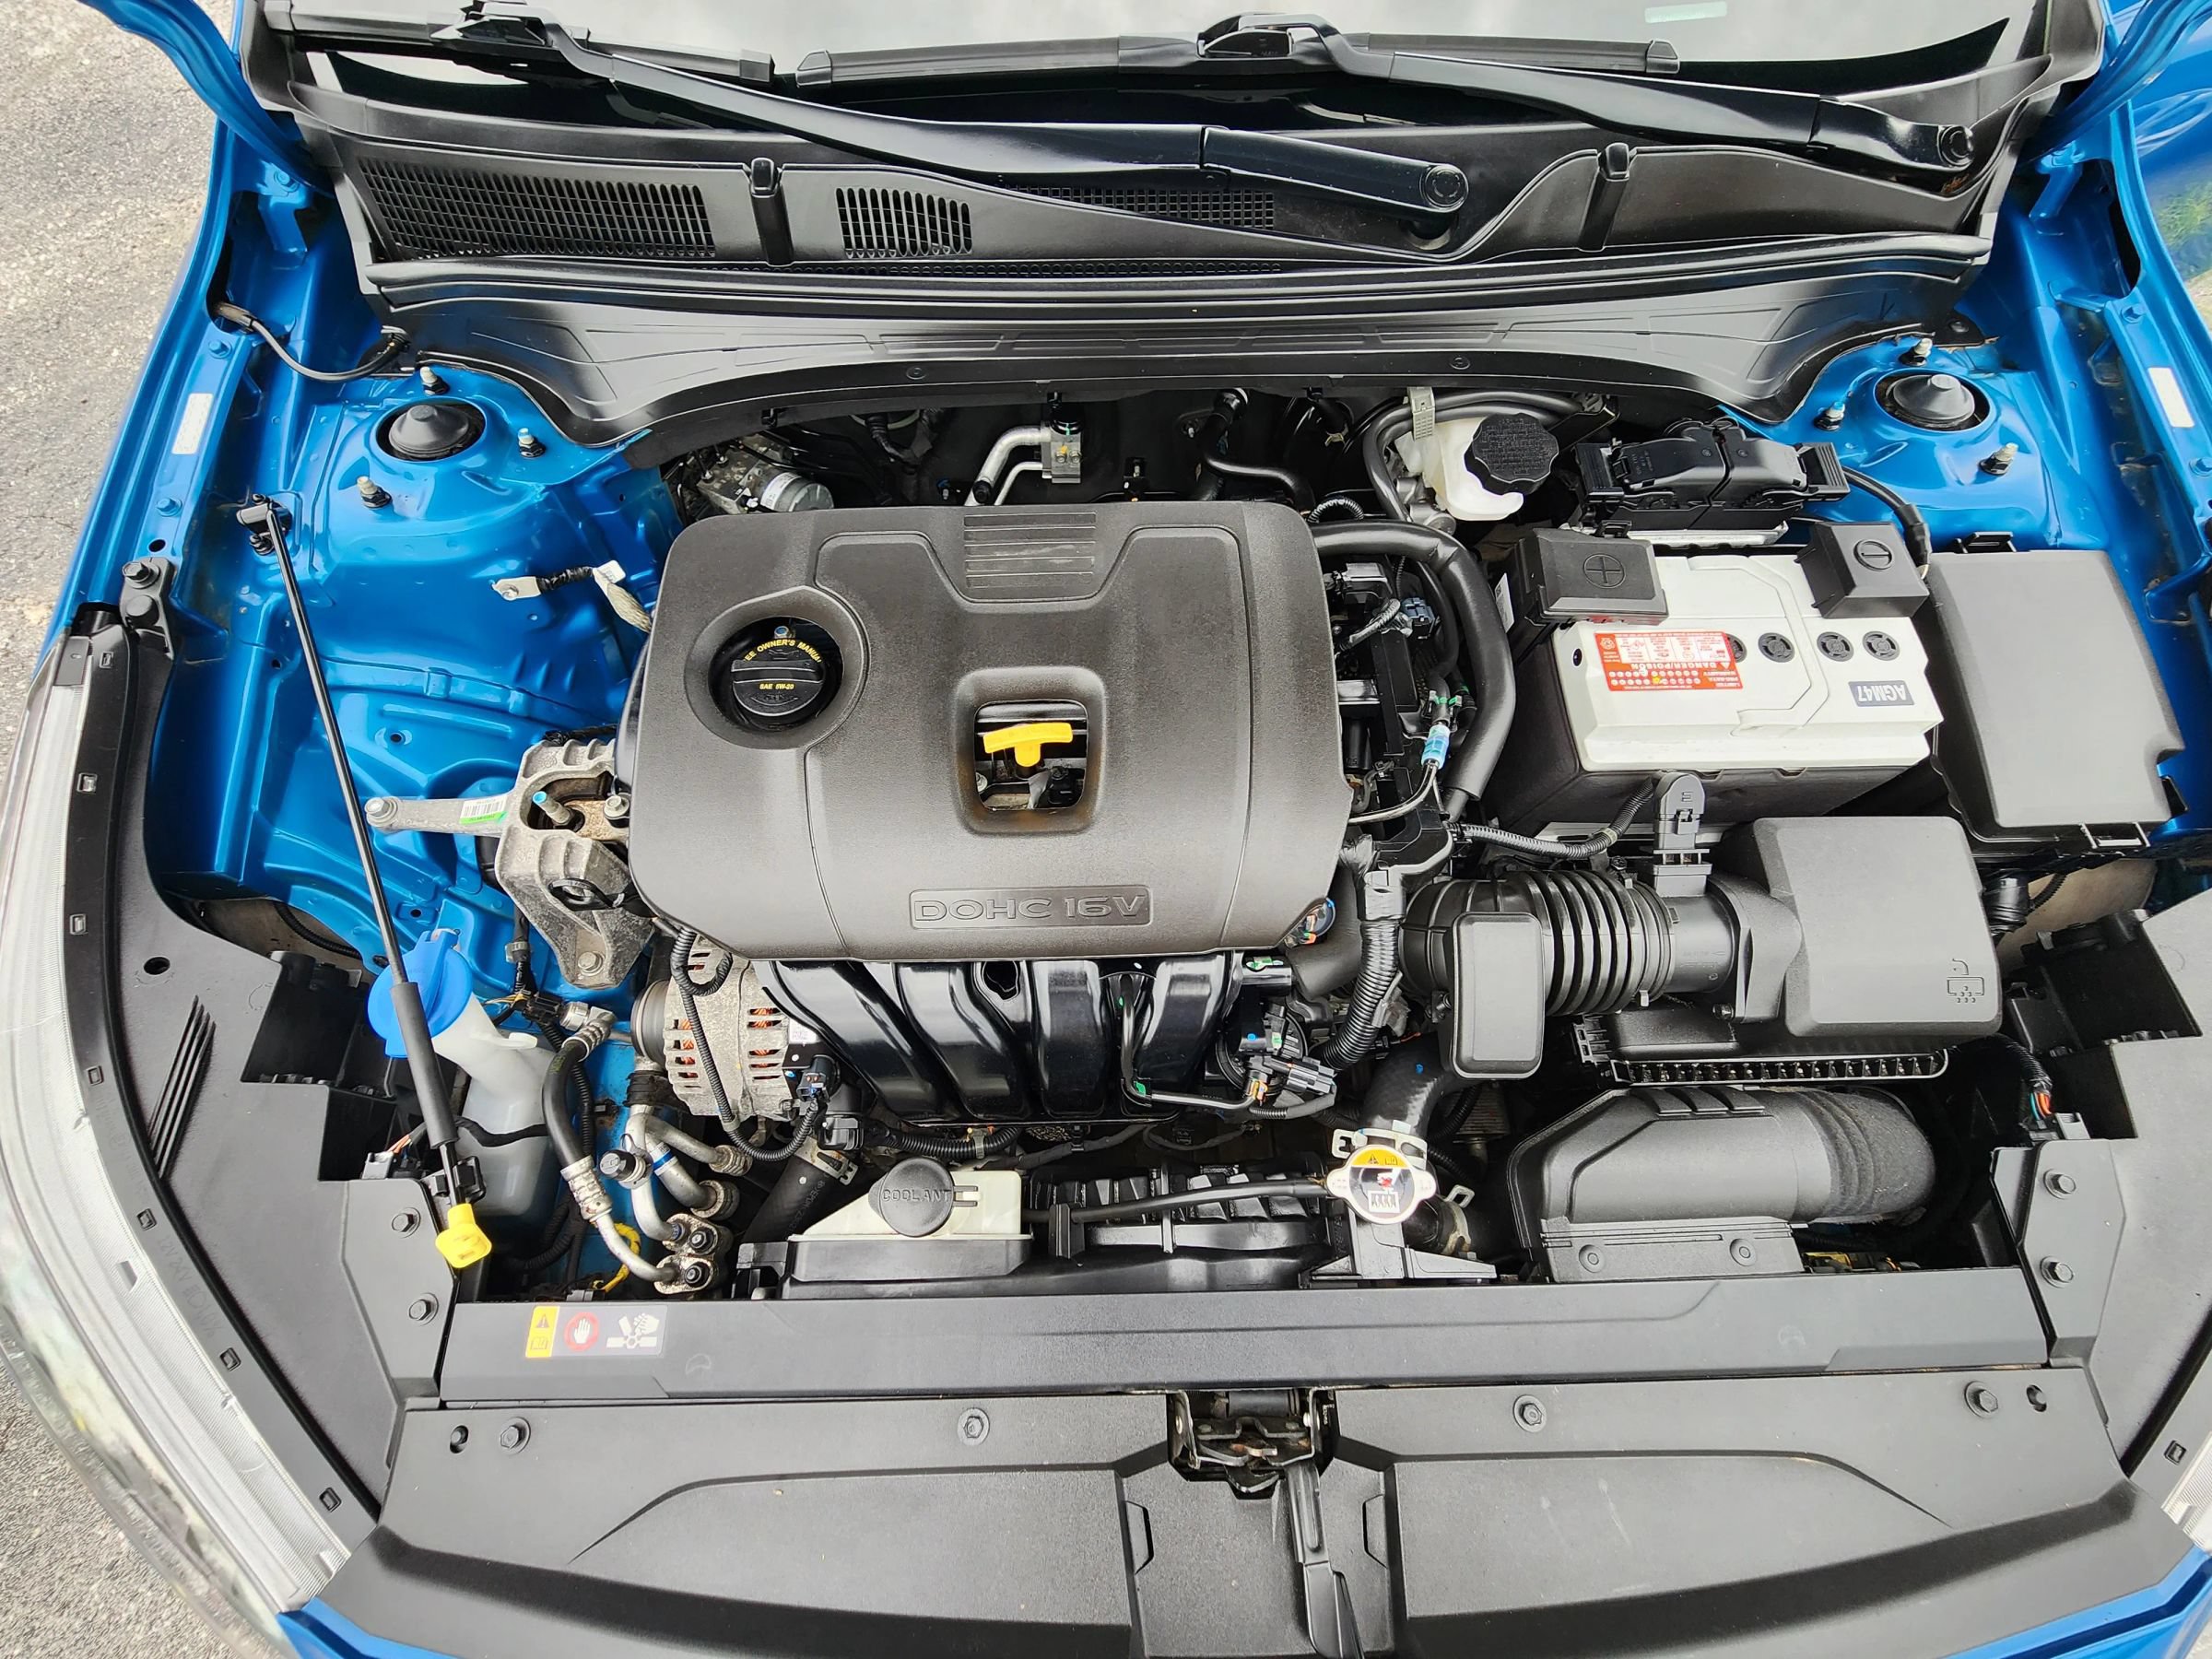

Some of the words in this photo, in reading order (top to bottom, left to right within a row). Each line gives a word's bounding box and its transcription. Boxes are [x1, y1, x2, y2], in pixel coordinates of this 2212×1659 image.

[757, 639, 795, 652] OWNER'S
[1858, 684, 1907, 702] AGM47
[913, 898, 1052, 921] DOHC
[1065, 894, 1147, 919] 16V
[882, 1188, 952, 1202] COOLANT
